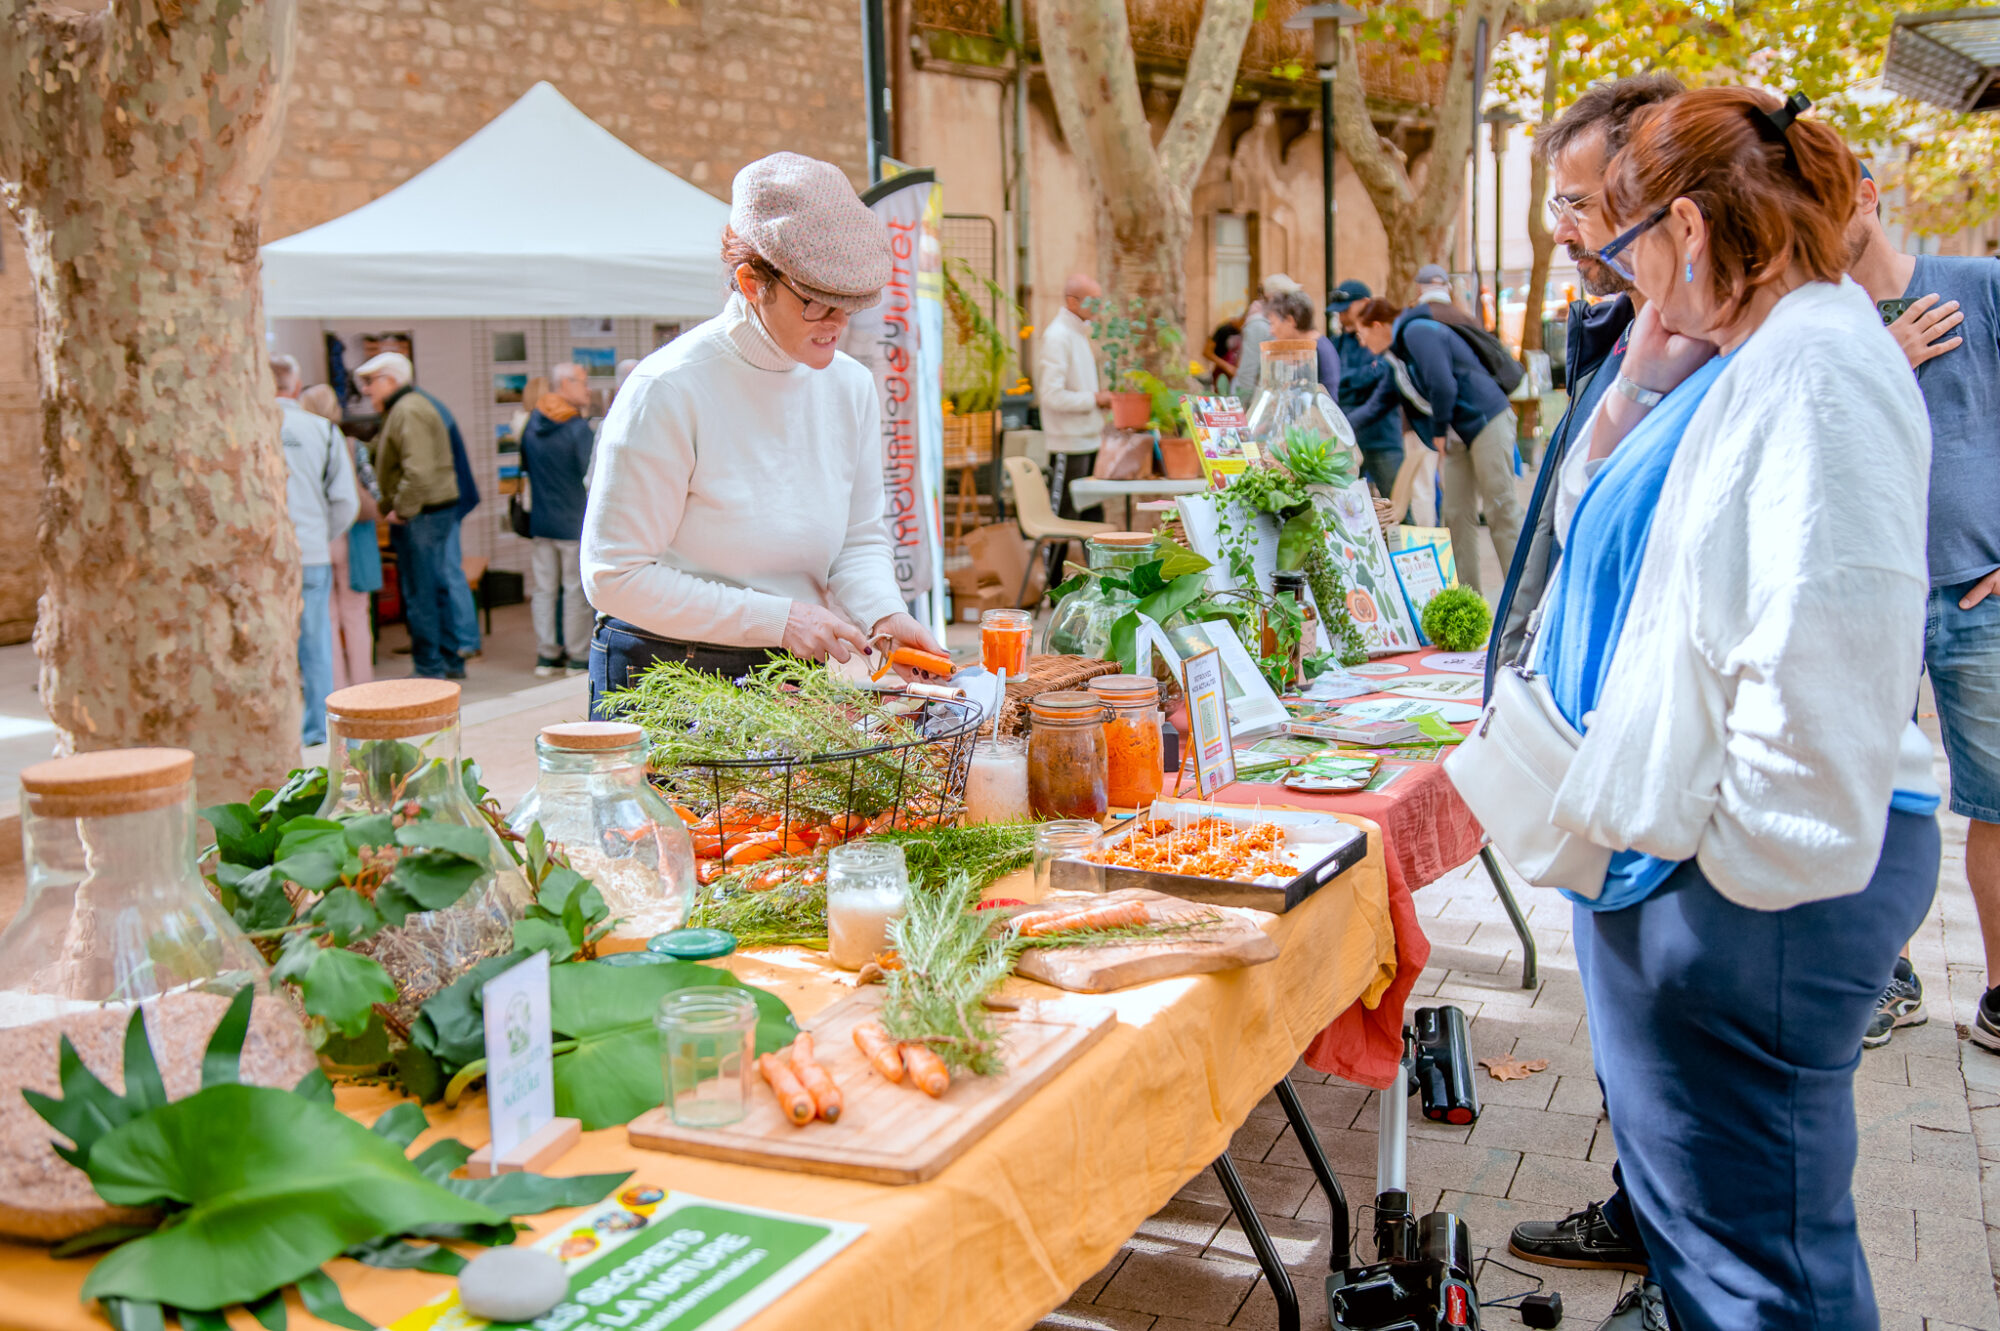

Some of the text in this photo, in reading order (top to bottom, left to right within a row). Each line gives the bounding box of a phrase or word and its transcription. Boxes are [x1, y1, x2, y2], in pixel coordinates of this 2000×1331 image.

[877, 321, 900, 362] du
[888, 419, 919, 546] moulin
[576, 1228, 706, 1306] SECRETS
[596, 1232, 751, 1328] LA NATURE
